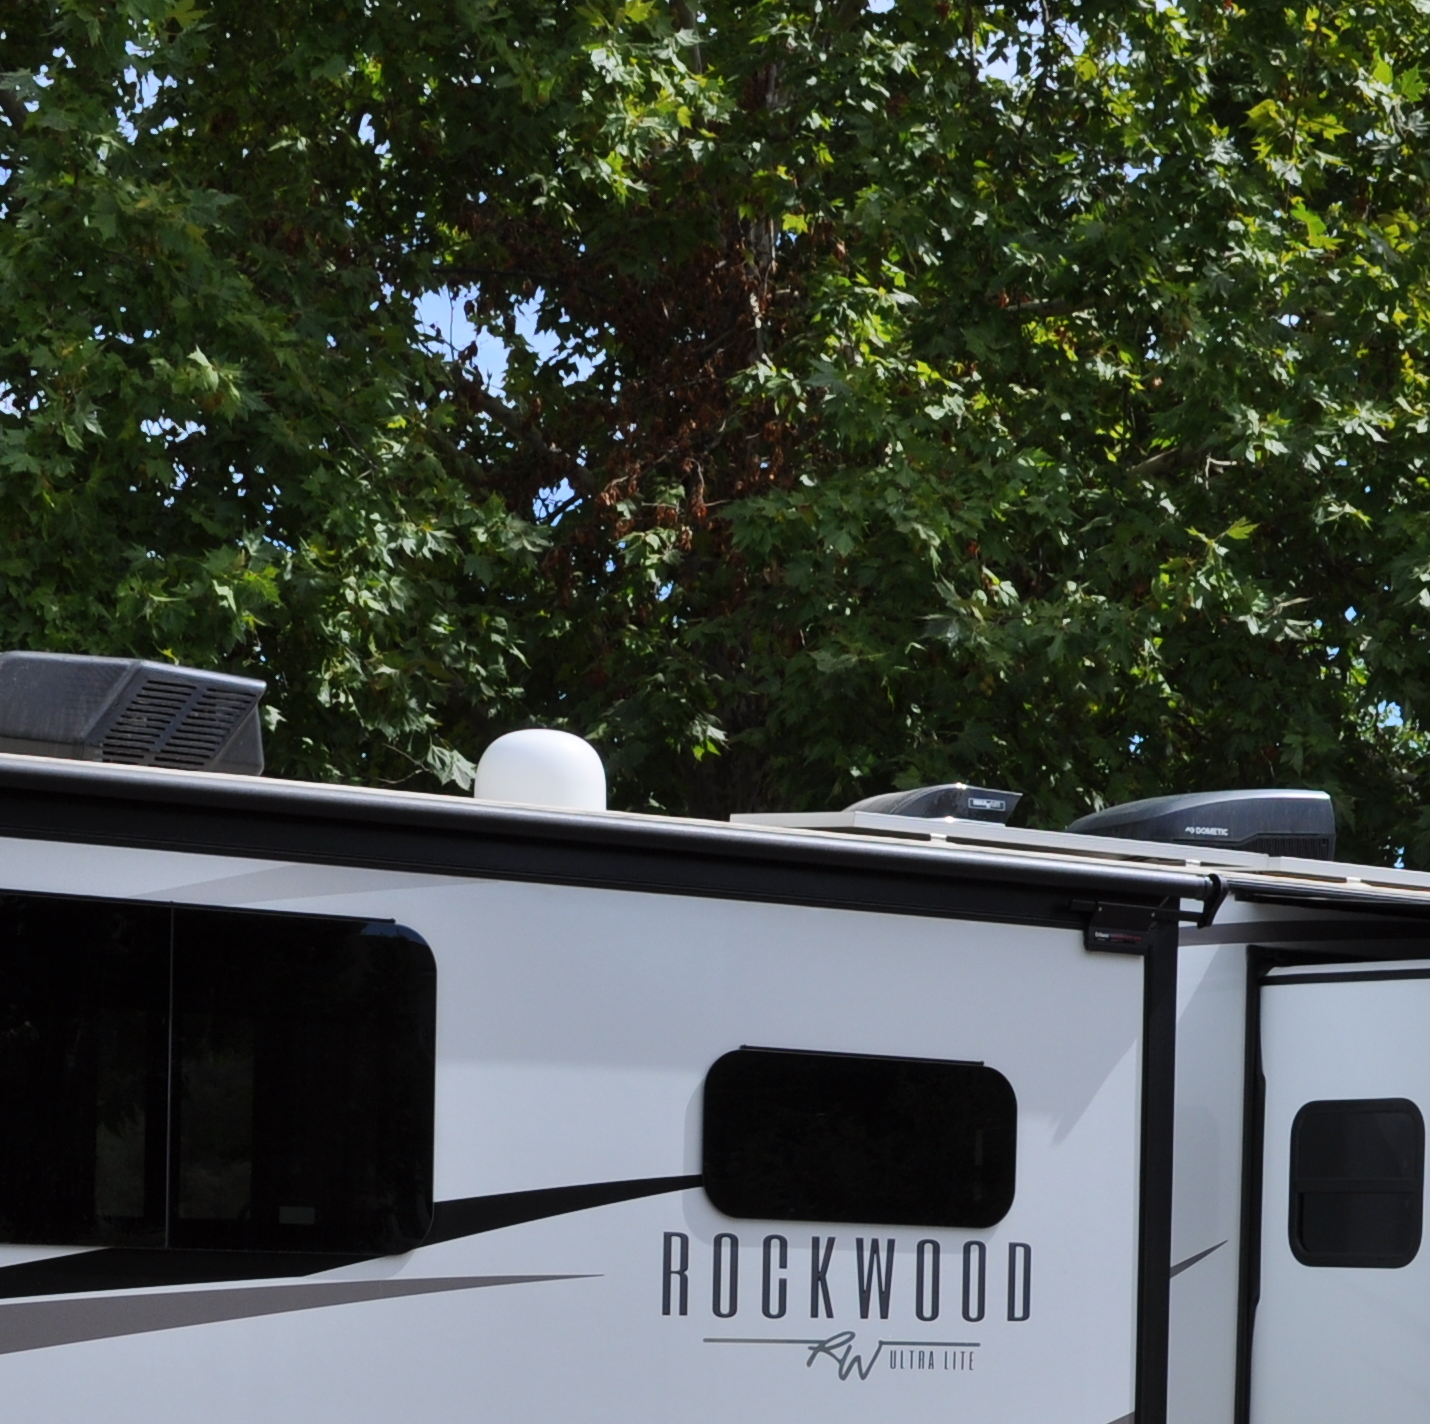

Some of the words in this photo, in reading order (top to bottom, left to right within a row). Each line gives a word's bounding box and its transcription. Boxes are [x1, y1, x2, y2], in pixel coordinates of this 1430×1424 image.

[1195, 826, 1229, 836] DOMETIC
[661, 1231, 1032, 1322] ROCKWOOD
[889, 1350, 934, 1370] ULTRA
[944, 1350, 974, 1371] LITE
